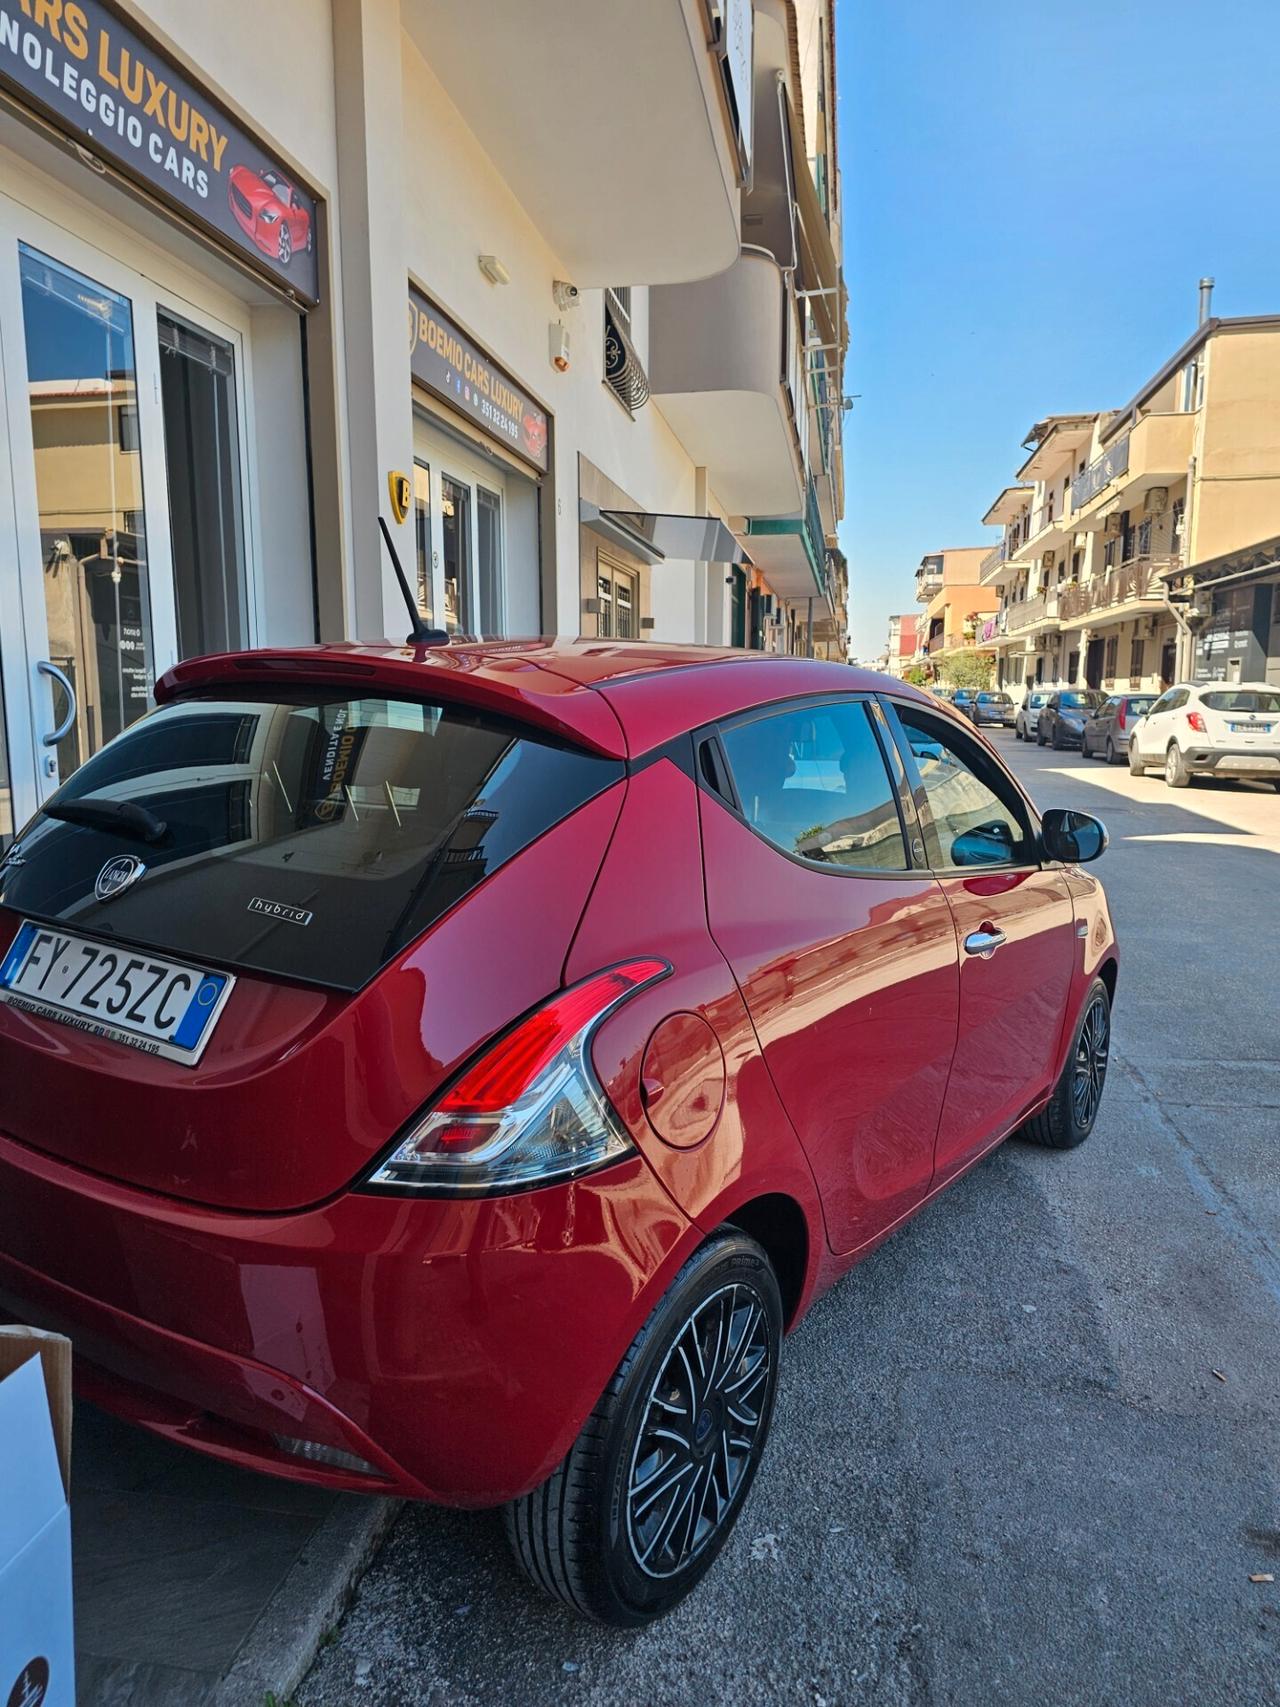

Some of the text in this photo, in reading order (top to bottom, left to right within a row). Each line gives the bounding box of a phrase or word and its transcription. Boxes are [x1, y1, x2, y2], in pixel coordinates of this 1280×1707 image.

[0, 9, 209, 199] NOLEGGIO CARS
[20, 0, 229, 173] RS LUXURY
[418, 311, 524, 423] BOEMIO CARS LUXURY
[401, 478, 410, 508] B
[254, 898, 305, 921] hybrid
[15, 933, 72, 991] FY
[60, 945, 192, 1031] 725ZC
[36, 1005, 58, 1019] CARS
[58, 1011, 94, 1031] LUXURY
[117, 1033, 129, 1043] 351
[129, 1037, 139, 1046] 32
[138, 1039, 148, 1050] 24
